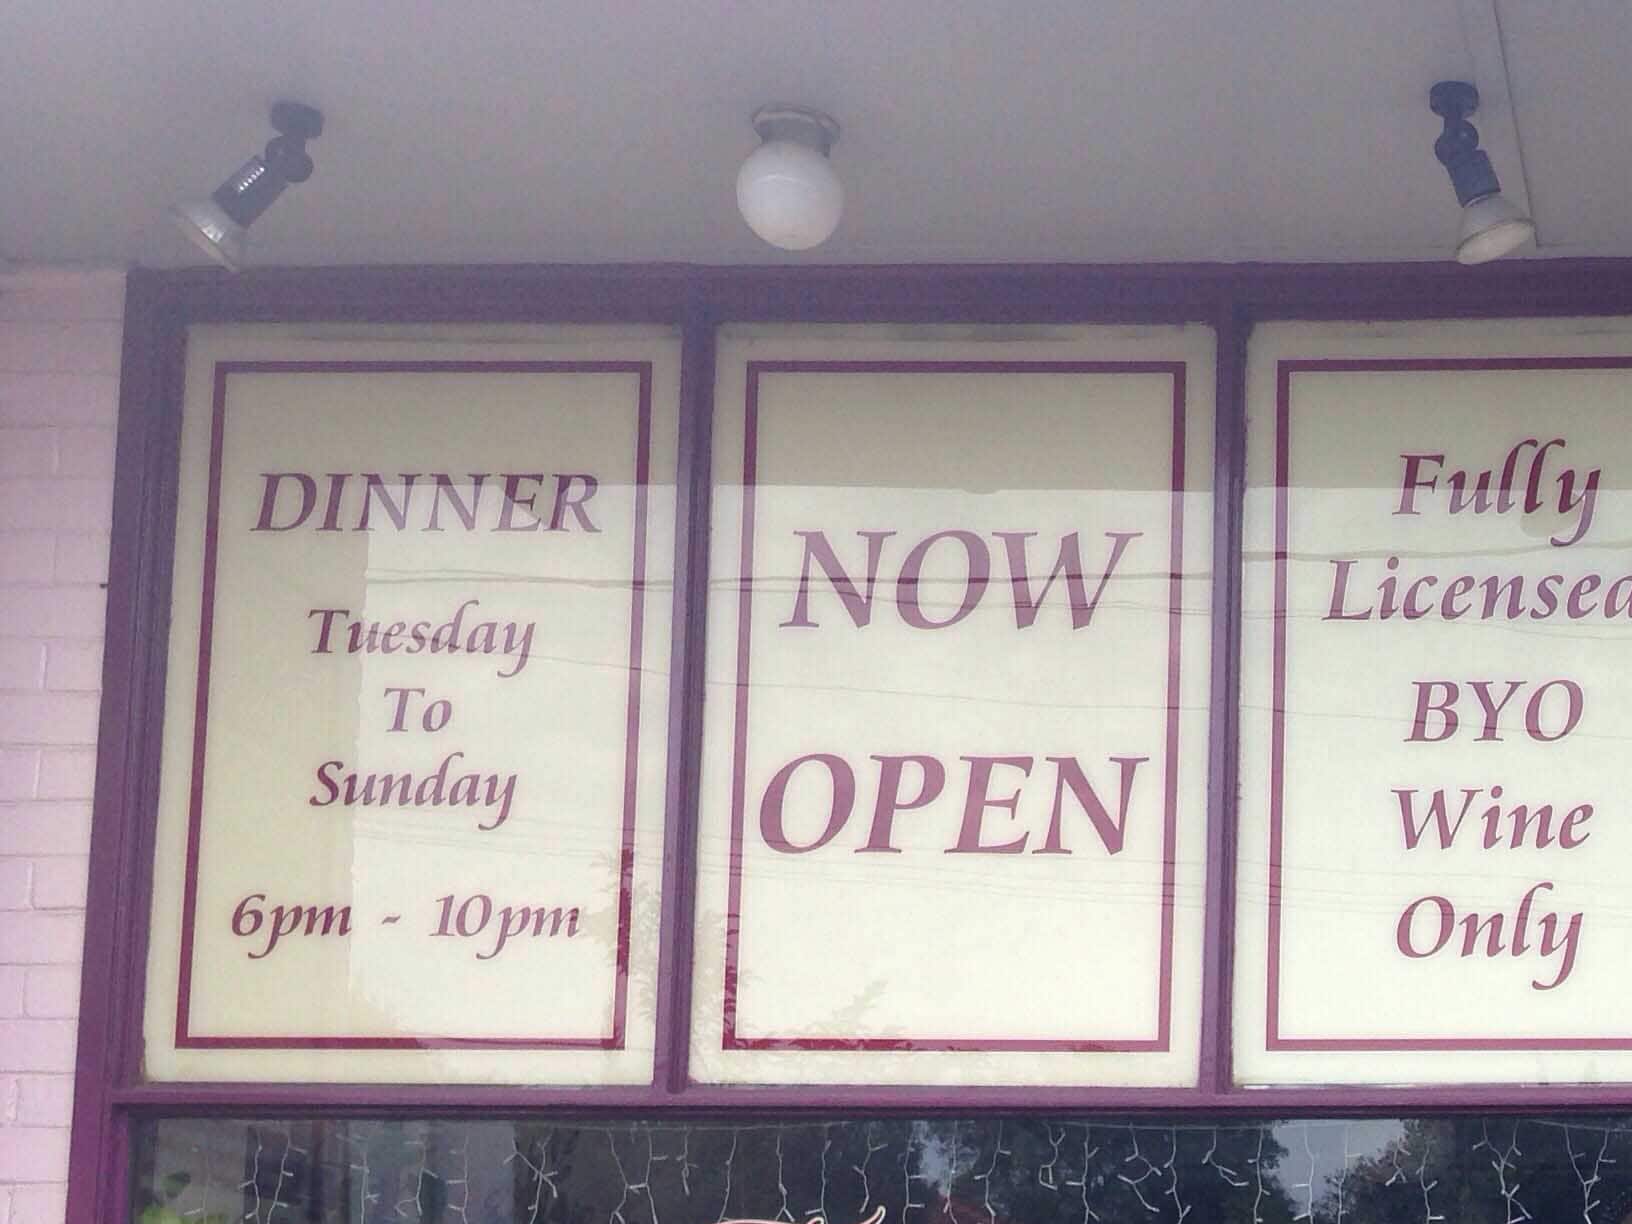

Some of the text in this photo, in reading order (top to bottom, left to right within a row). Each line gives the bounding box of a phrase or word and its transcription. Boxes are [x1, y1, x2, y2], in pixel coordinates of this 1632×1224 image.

[249, 472, 603, 534] DINNER
[1392, 439, 1601, 547] Fully
[779, 529, 1144, 630] NOW
[307, 600, 536, 678] Tuesday
[384, 687, 452, 733] To
[1403, 678, 1584, 742] BYO
[309, 752, 518, 831] Sunday
[759, 753, 1150, 855] OPEN
[1391, 785, 1593, 850] Wine
[231, 893, 353, 959] 6pm
[428, 893, 581, 960] 10pm
[1395, 882, 1583, 990] Only
